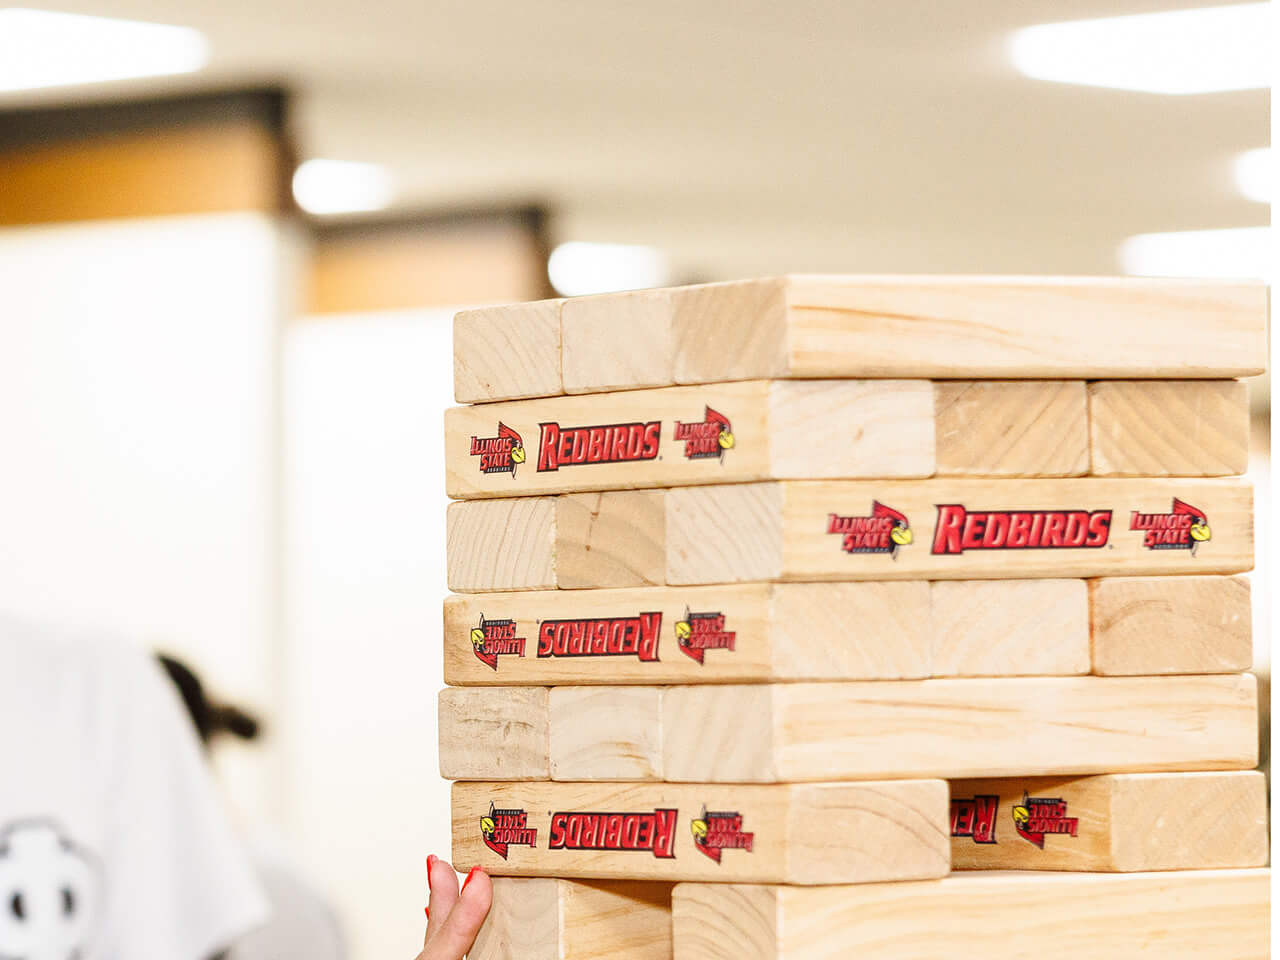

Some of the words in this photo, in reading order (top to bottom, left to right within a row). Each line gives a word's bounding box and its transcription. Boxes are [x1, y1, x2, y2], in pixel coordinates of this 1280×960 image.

[674, 421, 720, 441] ILLINOIS
[470, 436, 512, 456] ILLINOIS
[537, 421, 662, 472] REDBIRDS
[685, 438, 719, 457] STATE
[480, 452, 511, 470] STATE
[827, 513, 892, 534] ILLINOIS
[931, 504, 1113, 555] REDBIRDS
[1129, 511, 1192, 531] ILLINOIS
[842, 531, 890, 550] STATE
[1143, 529, 1189, 547] STATE
[484, 622, 516, 639] STATE
[537, 612, 662, 662] REDBIRDS
[484, 637, 526, 657] ILLINOIS
[495, 813, 527, 830] STATE
[493, 828, 537, 848] ILLINOIS
[549, 808, 678, 859] REDBIRDS
